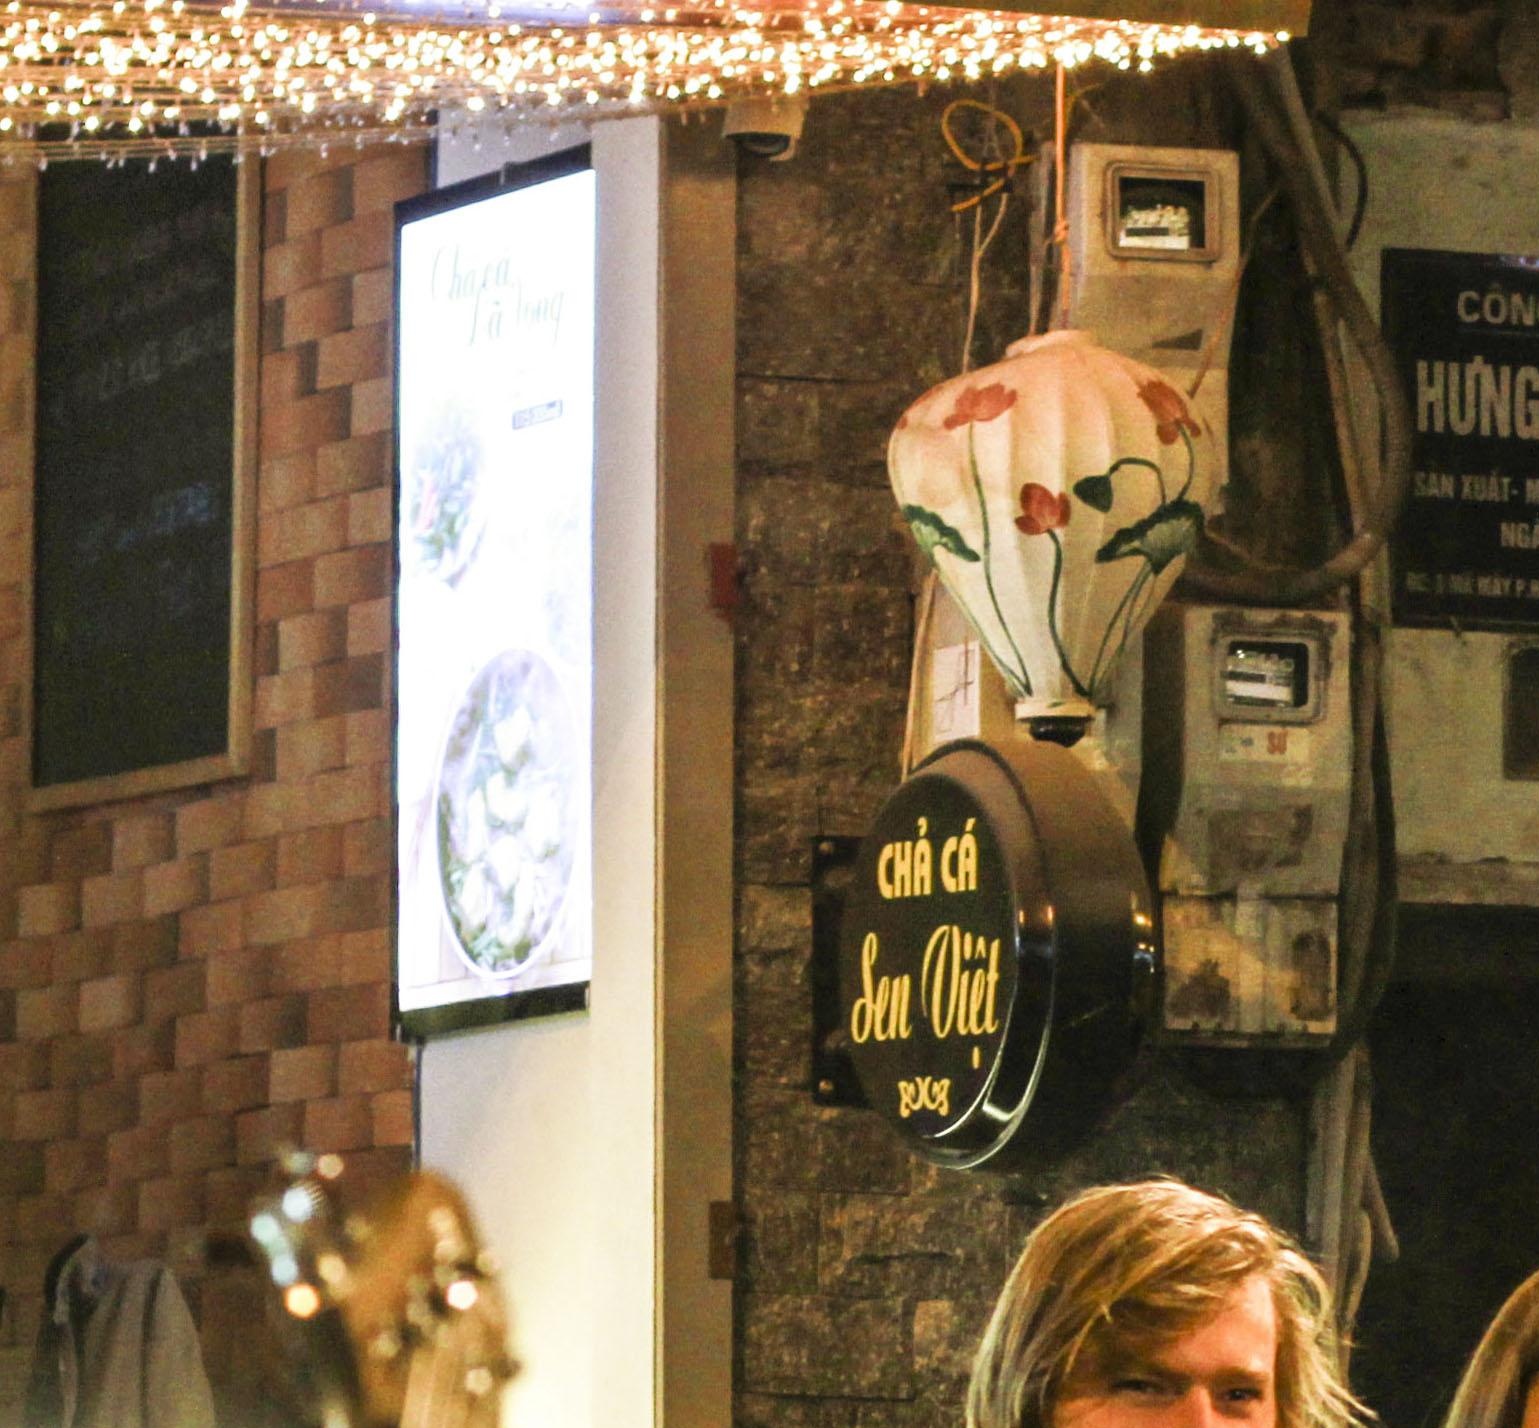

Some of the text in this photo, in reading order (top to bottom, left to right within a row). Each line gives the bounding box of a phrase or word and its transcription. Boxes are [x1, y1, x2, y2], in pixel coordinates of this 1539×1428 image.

[878, 816, 978, 899] CHẢ CÁ
[851, 924, 1001, 1069] Sen Việt
